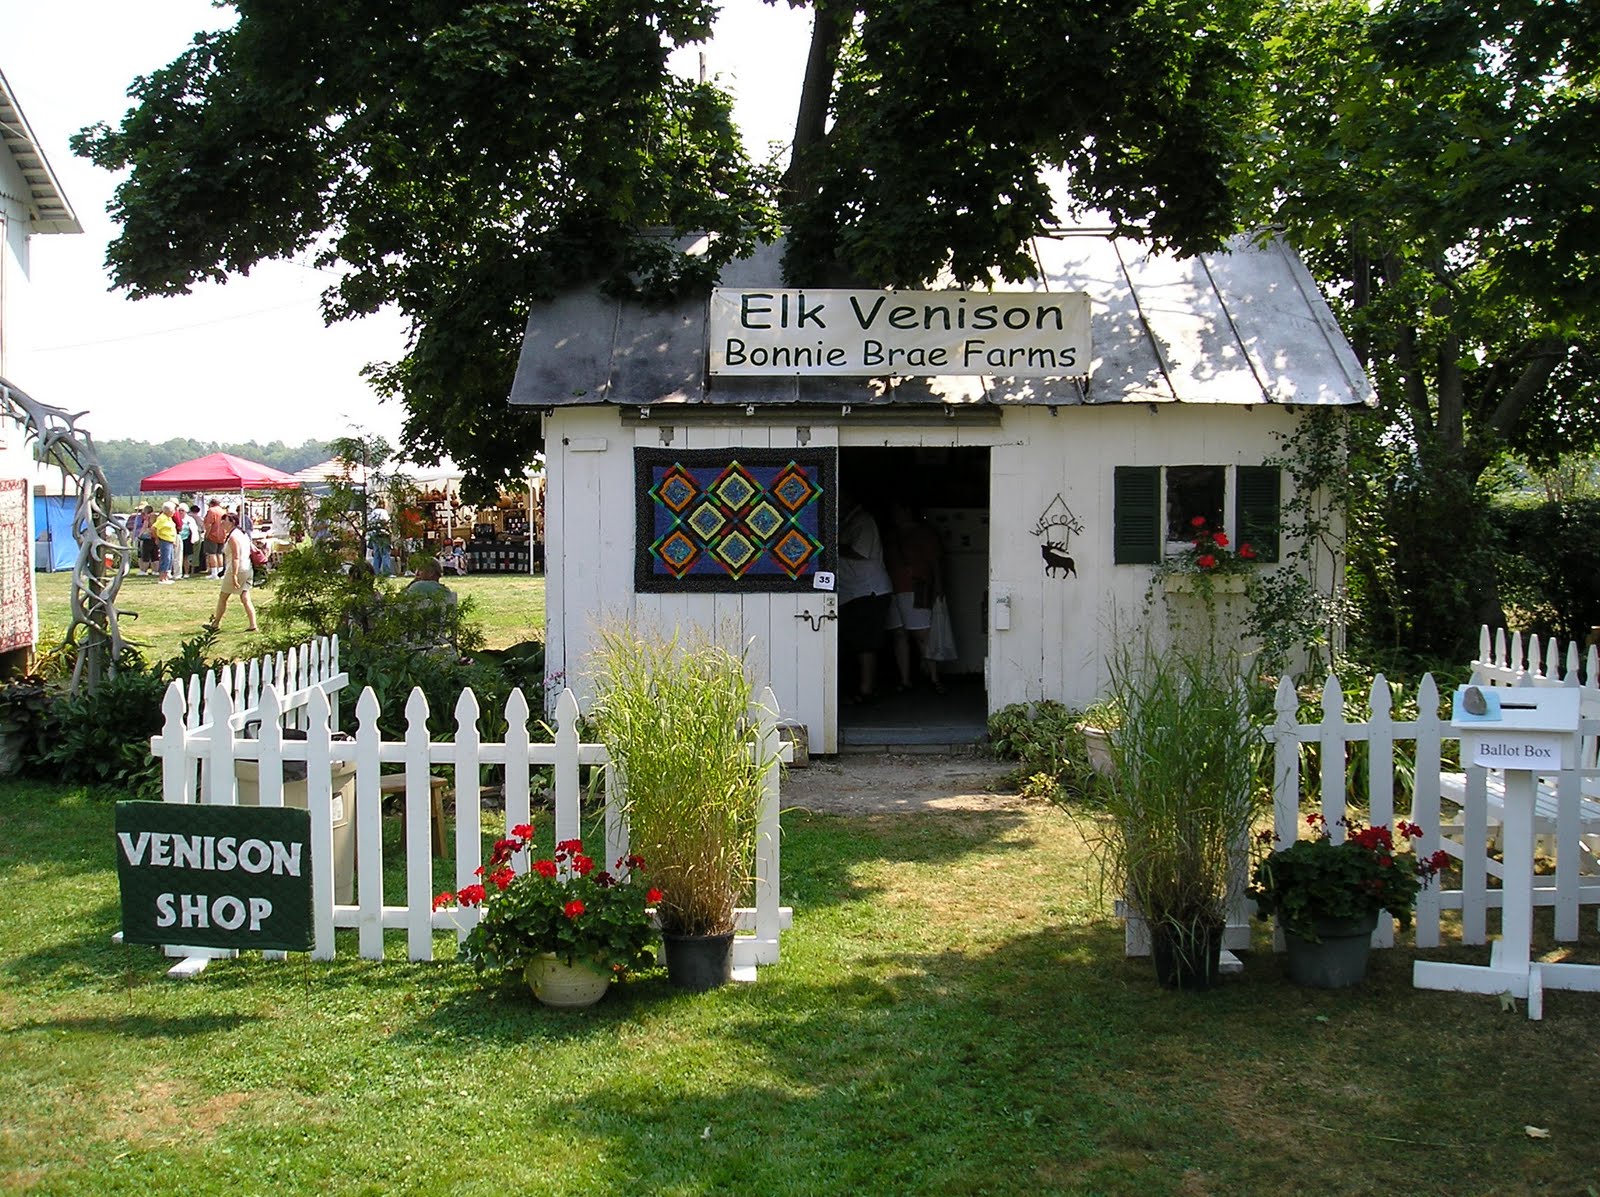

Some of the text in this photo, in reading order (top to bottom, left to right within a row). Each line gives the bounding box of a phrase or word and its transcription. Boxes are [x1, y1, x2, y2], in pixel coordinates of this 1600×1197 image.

[740, 290, 1064, 331] Elk Venison
[725, 338, 1076, 369] Bonnie Brae Farms
[1029, 514, 1085, 536] WELCOME
[818, 576, 831, 584] 35
[1480, 743, 1552, 758] Ballot Box
[117, 832, 302, 877] VENISON
[156, 893, 273, 931] SHOP
